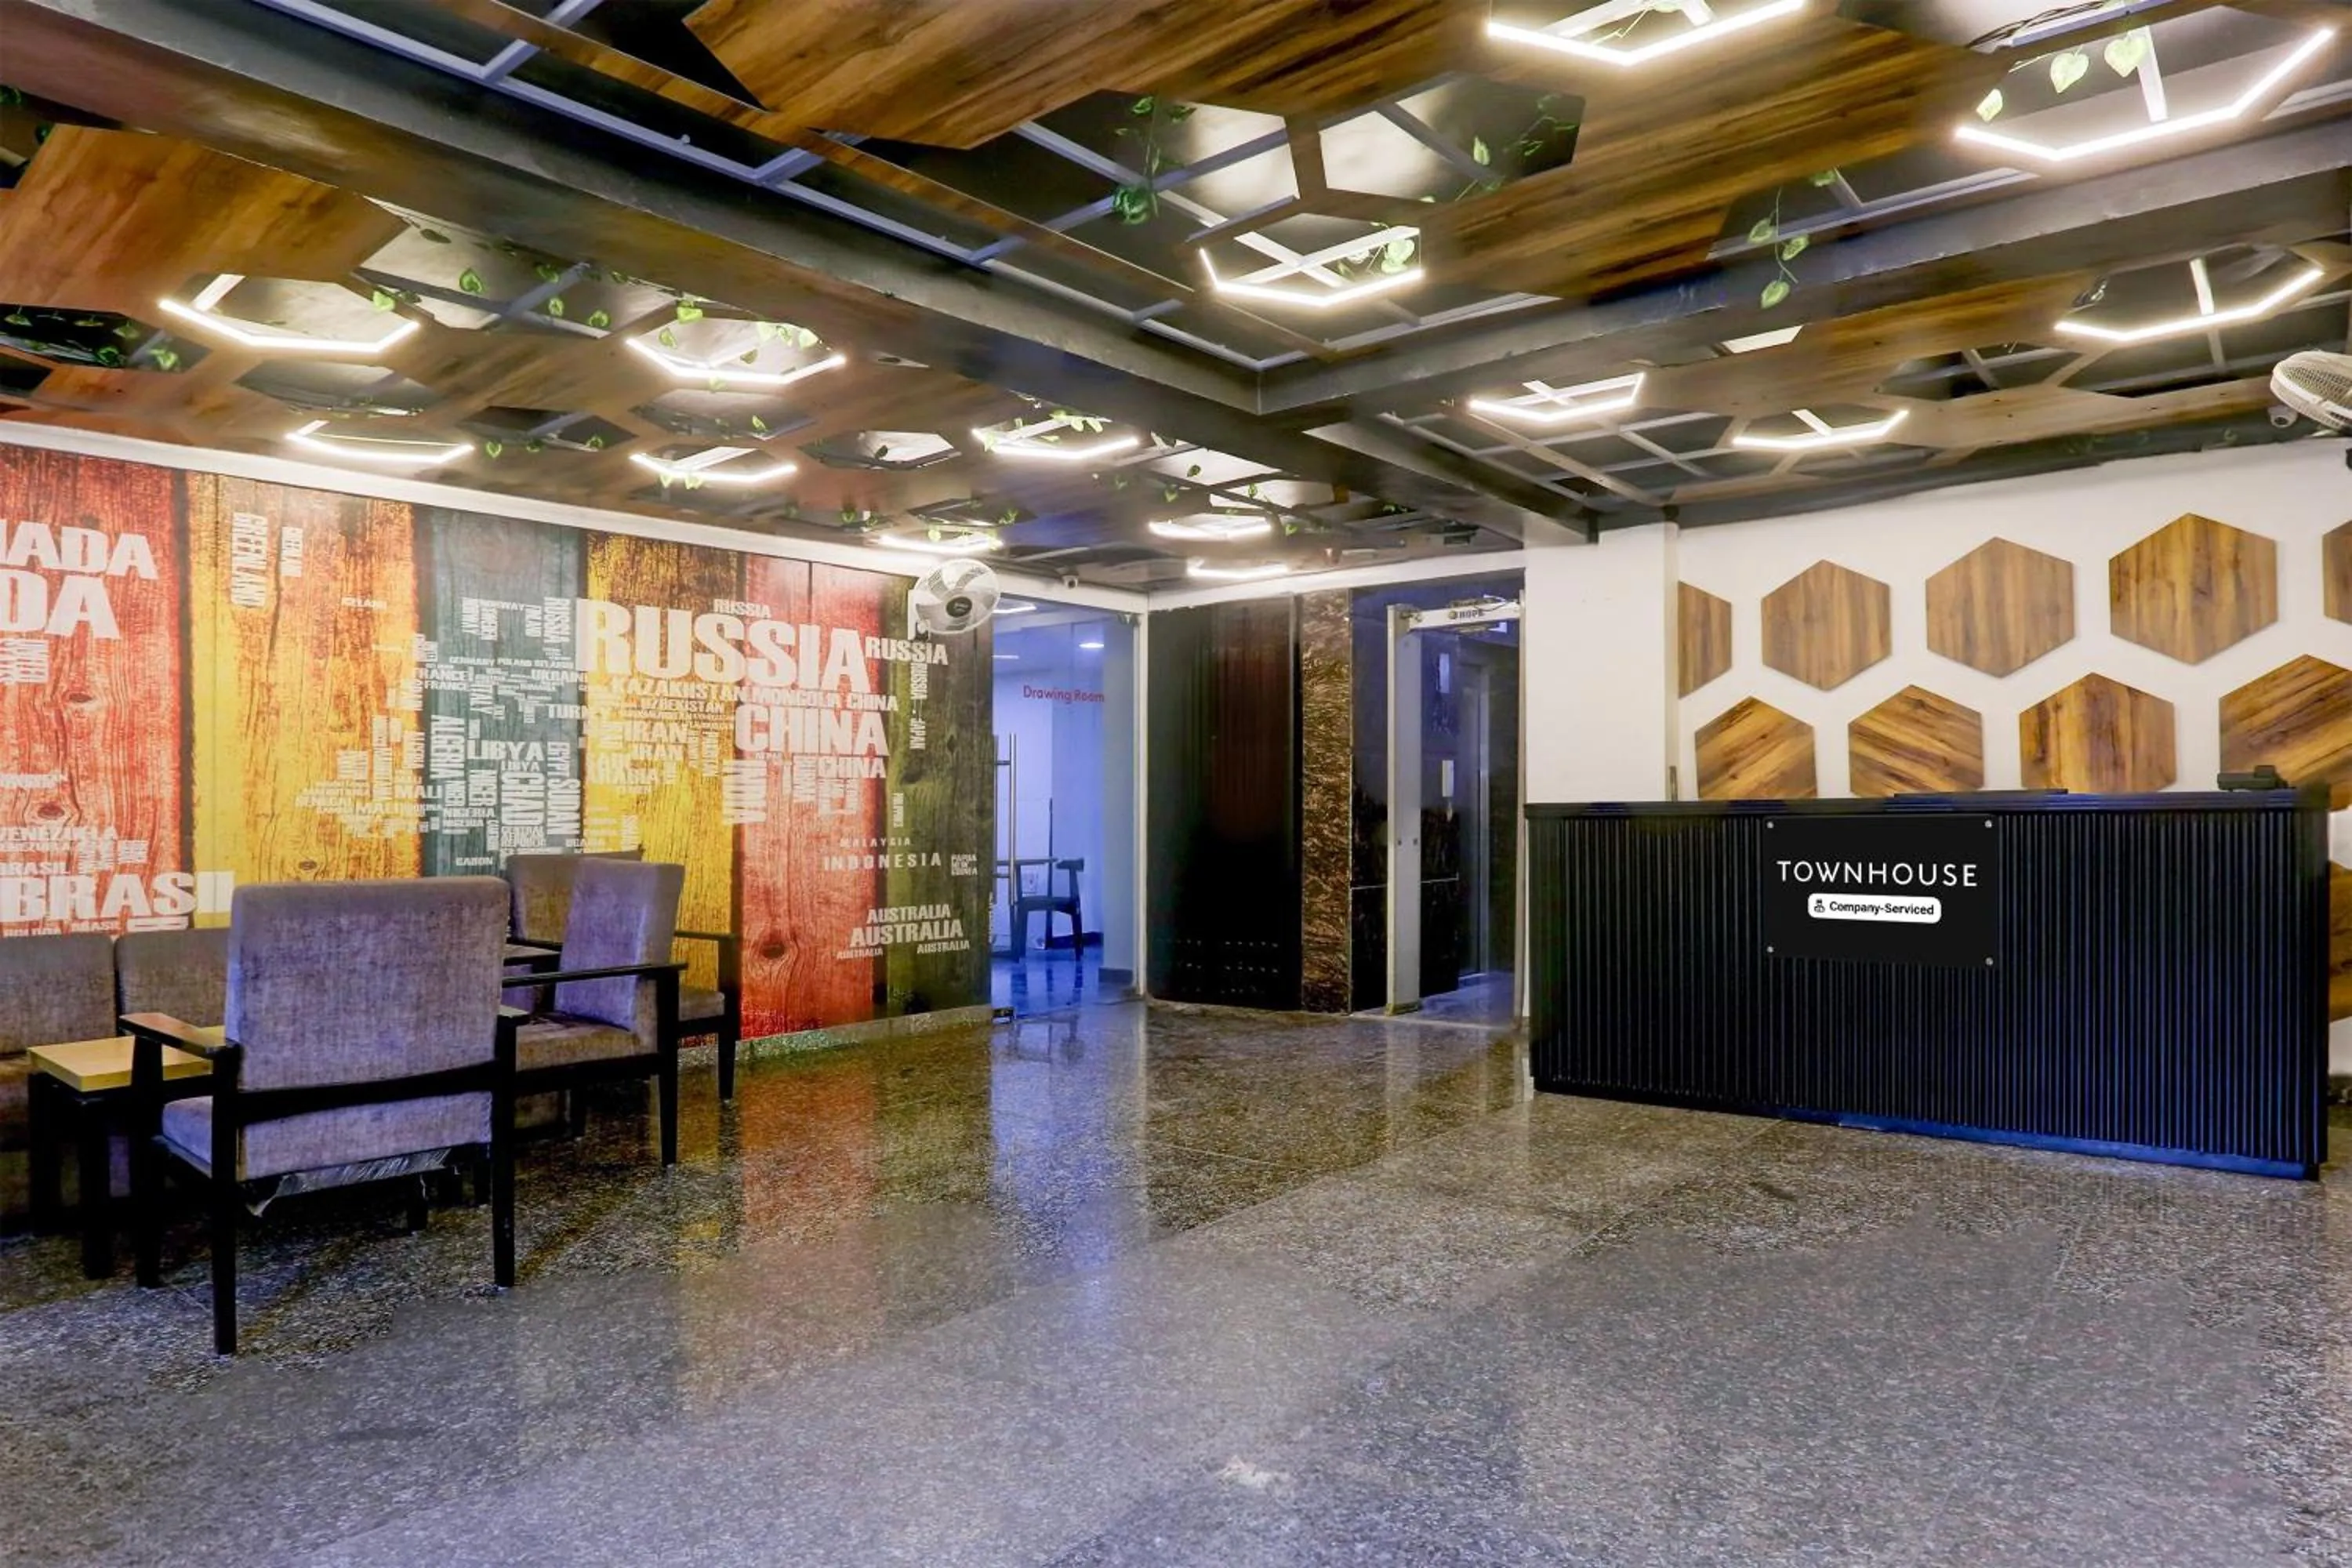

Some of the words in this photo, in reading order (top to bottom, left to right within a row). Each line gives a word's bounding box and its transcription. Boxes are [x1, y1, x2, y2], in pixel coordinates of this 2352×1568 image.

[0, 518, 158, 580] ADA
[230, 511, 268, 608] GREENLAND
[543, 597, 572, 644] RUSSIA
[713, 598, 771, 619] RUSSIA
[575, 598, 871, 692] RUSSIA
[864, 636, 949, 666] RUSSIA
[910, 662, 927, 700] RUSSIA
[1023, 684, 1072, 704] Drawing
[1073, 689, 1105, 703] Room
[849, 695, 898, 712] CHINA
[735, 705, 889, 757] CHINA
[909, 715, 927, 750] JAPAN
[430, 714, 466, 779] ALGERIA
[467, 739, 544, 760] LIBYA
[547, 741, 571, 778] EGYPT
[501, 760, 540, 772] LIBYA
[818, 757, 886, 779] CHINA
[468, 769, 498, 807] NIGER
[501, 771, 546, 826] CHAD
[721, 760, 768, 823] INDIA
[547, 779, 581, 835] SUDAN
[840, 836, 911, 848] MALAYSIA
[823, 851, 942, 872] INDONESIA
[1777, 860, 1978, 887] TOWNHOUSE
[866, 903, 951, 924] AUSTRALIA
[1829, 901, 1935, 916] Company-Serviced
[849, 918, 964, 949] AUSTRALIA
[916, 939, 971, 955] AUSTRALIA
[837, 947, 884, 960] AUSTRALIA
